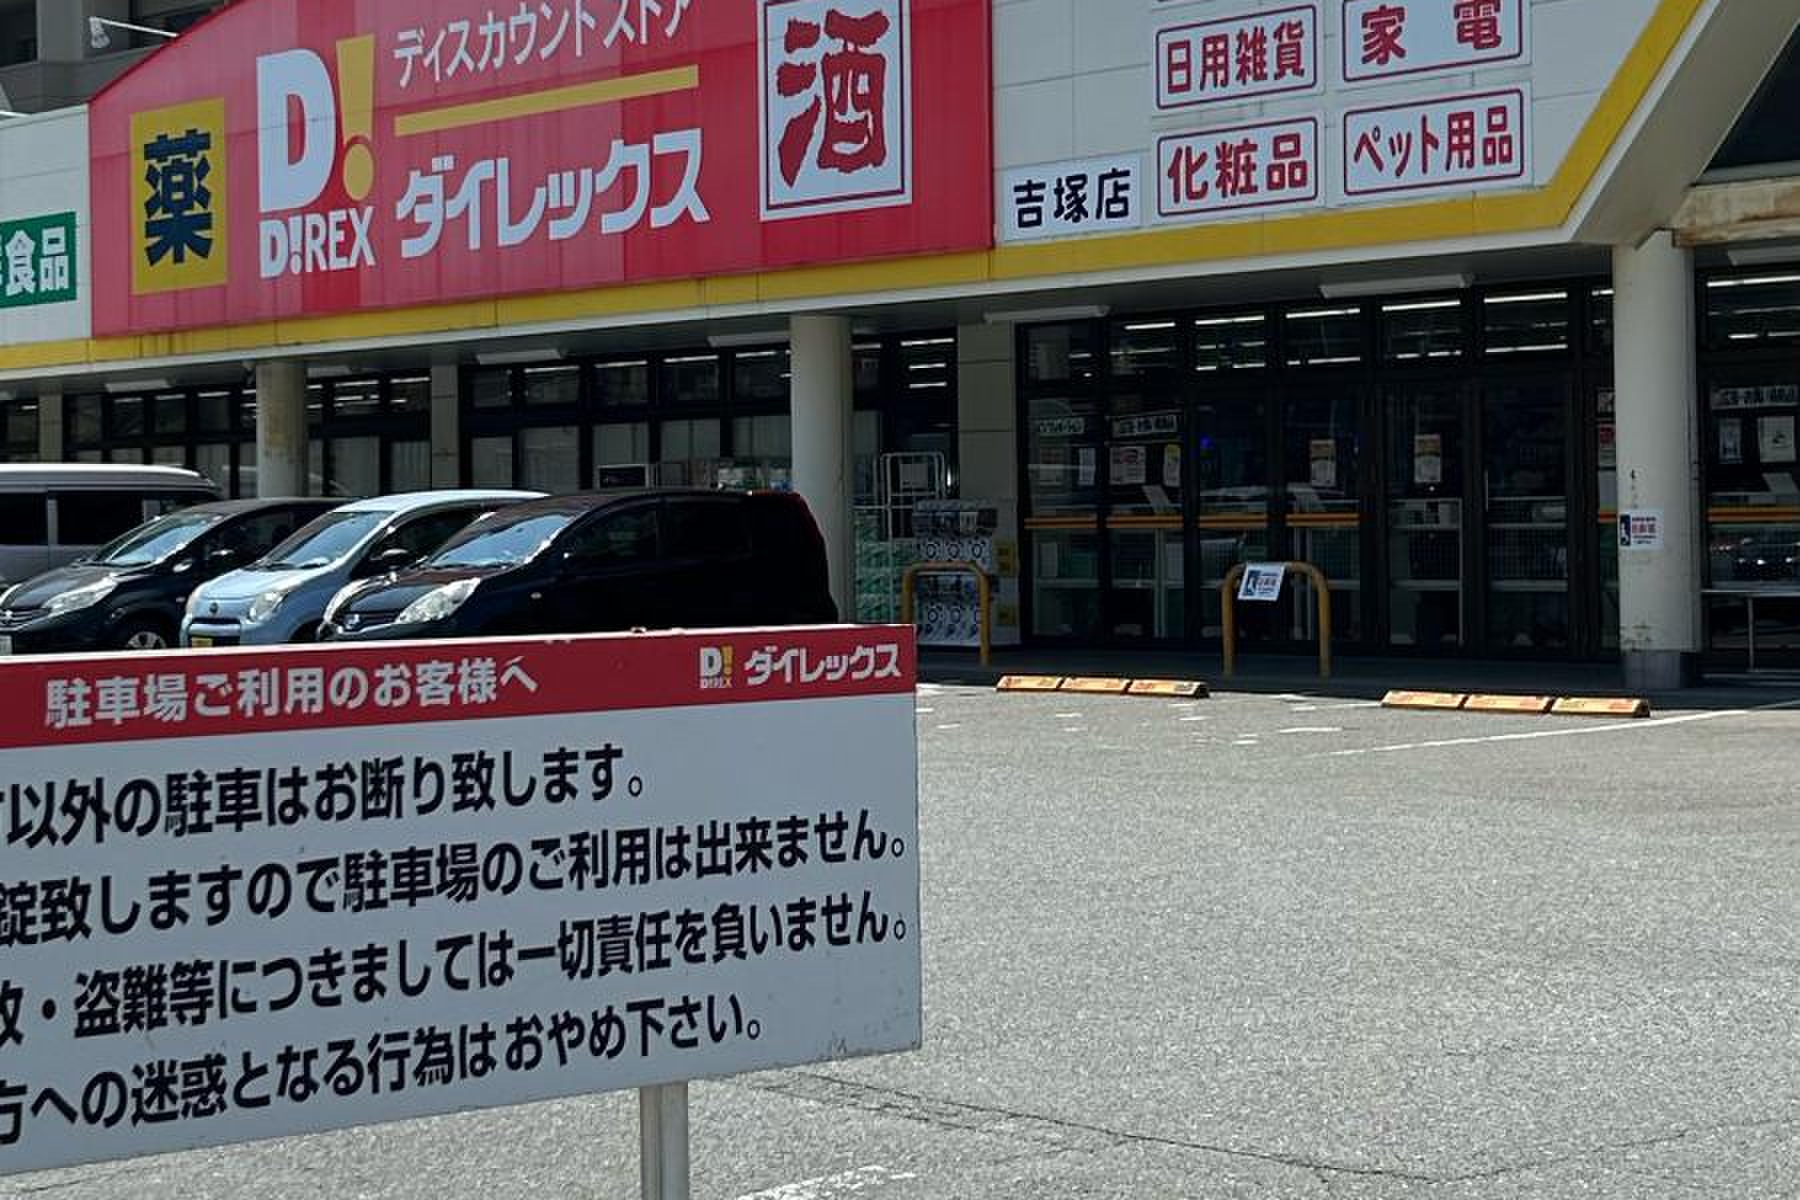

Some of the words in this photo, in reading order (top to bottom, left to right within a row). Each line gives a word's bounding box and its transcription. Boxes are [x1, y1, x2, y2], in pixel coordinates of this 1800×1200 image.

[1166, 21, 1306, 94] 日用雑貨
[776, 8, 891, 187] 酒
[1167, 133, 1308, 204] 化粧品
[1353, 106, 1513, 178] ペット用品
[143, 130, 213, 266] 薬
[396, 127, 711, 259] ダイレックス
[1012, 167, 1131, 230] 吉塚店
[0, 226, 69, 297] 食品
[259, 207, 377, 278] D!REX
[45, 655, 538, 729] 駐車場ご利用のお客様へ
[744, 643, 902, 686] ダイレックス
[0, 743, 645, 848] 以外の駐車はお断り致します。
